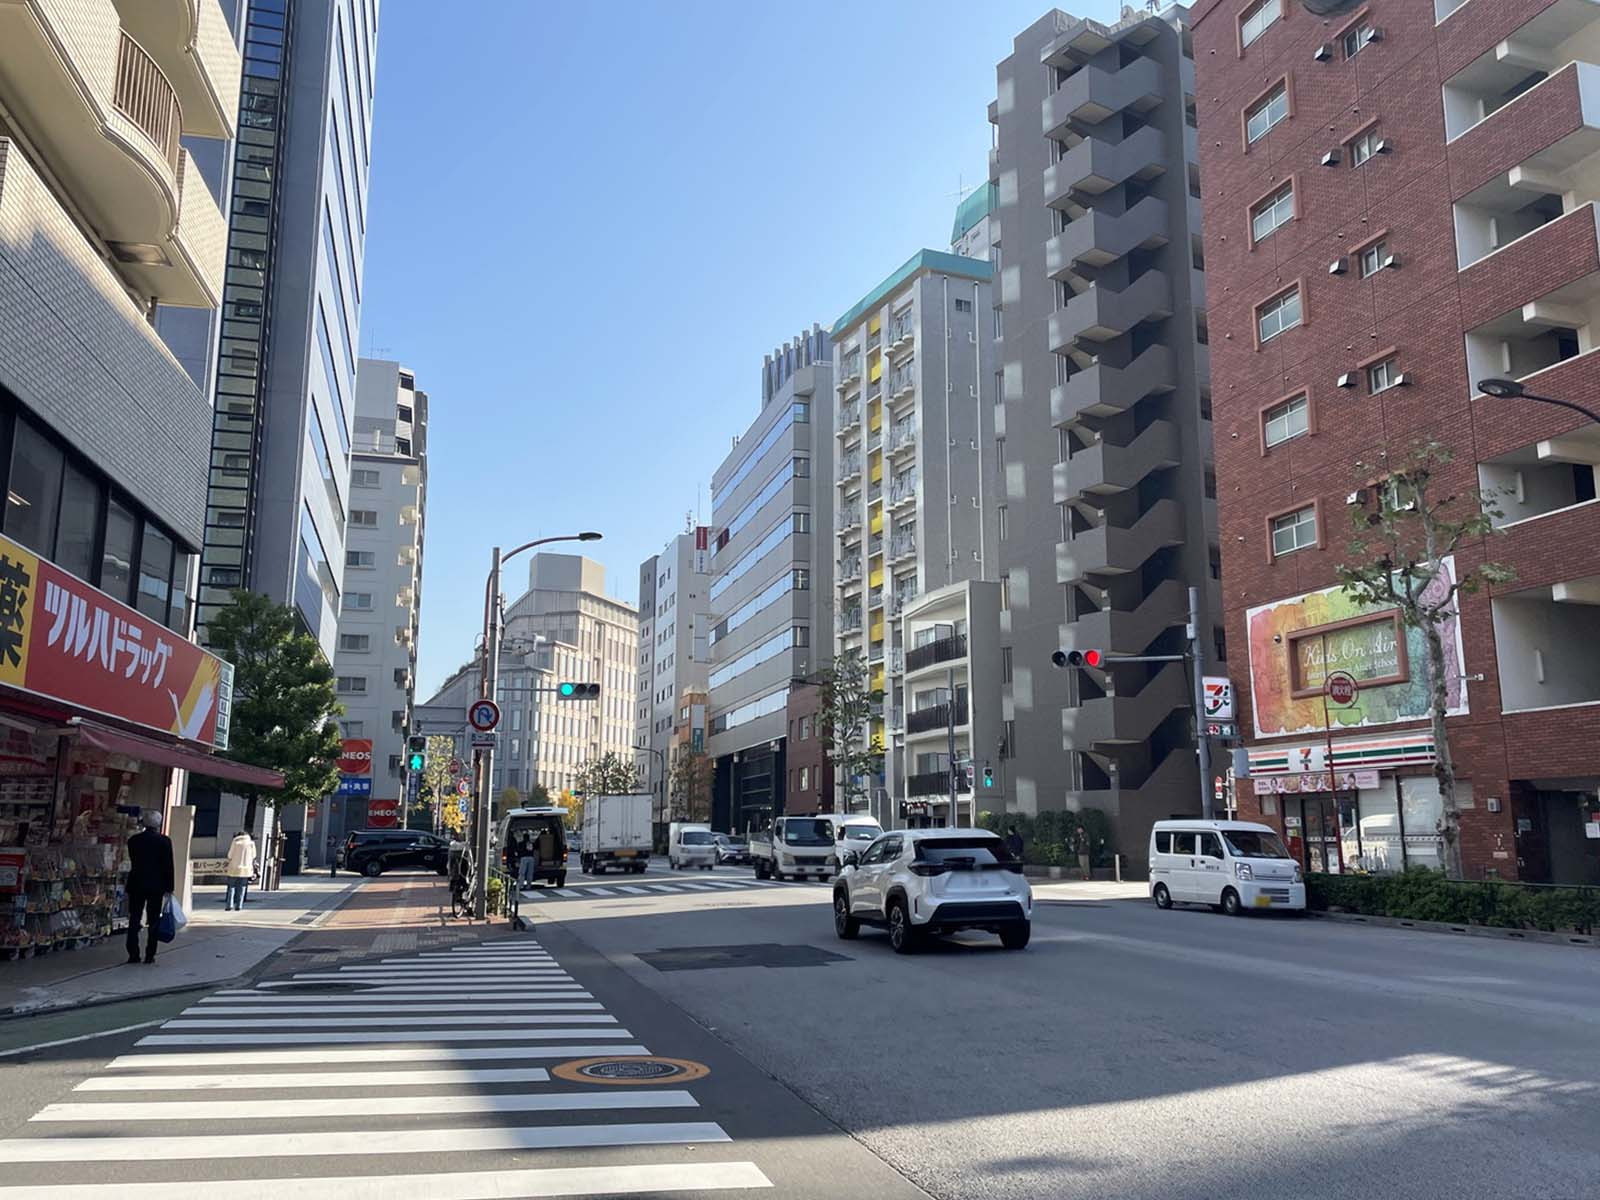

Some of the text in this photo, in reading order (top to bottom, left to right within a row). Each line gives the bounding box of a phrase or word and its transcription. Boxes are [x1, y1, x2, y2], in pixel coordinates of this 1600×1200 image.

[44, 580, 173, 688] ツルハドラッグ
[1303, 641, 1338, 668] Kids
[1342, 638, 1365, 660] On
[337, 751, 371, 760] NEOS
[368, 809, 397, 817] ENEOS
